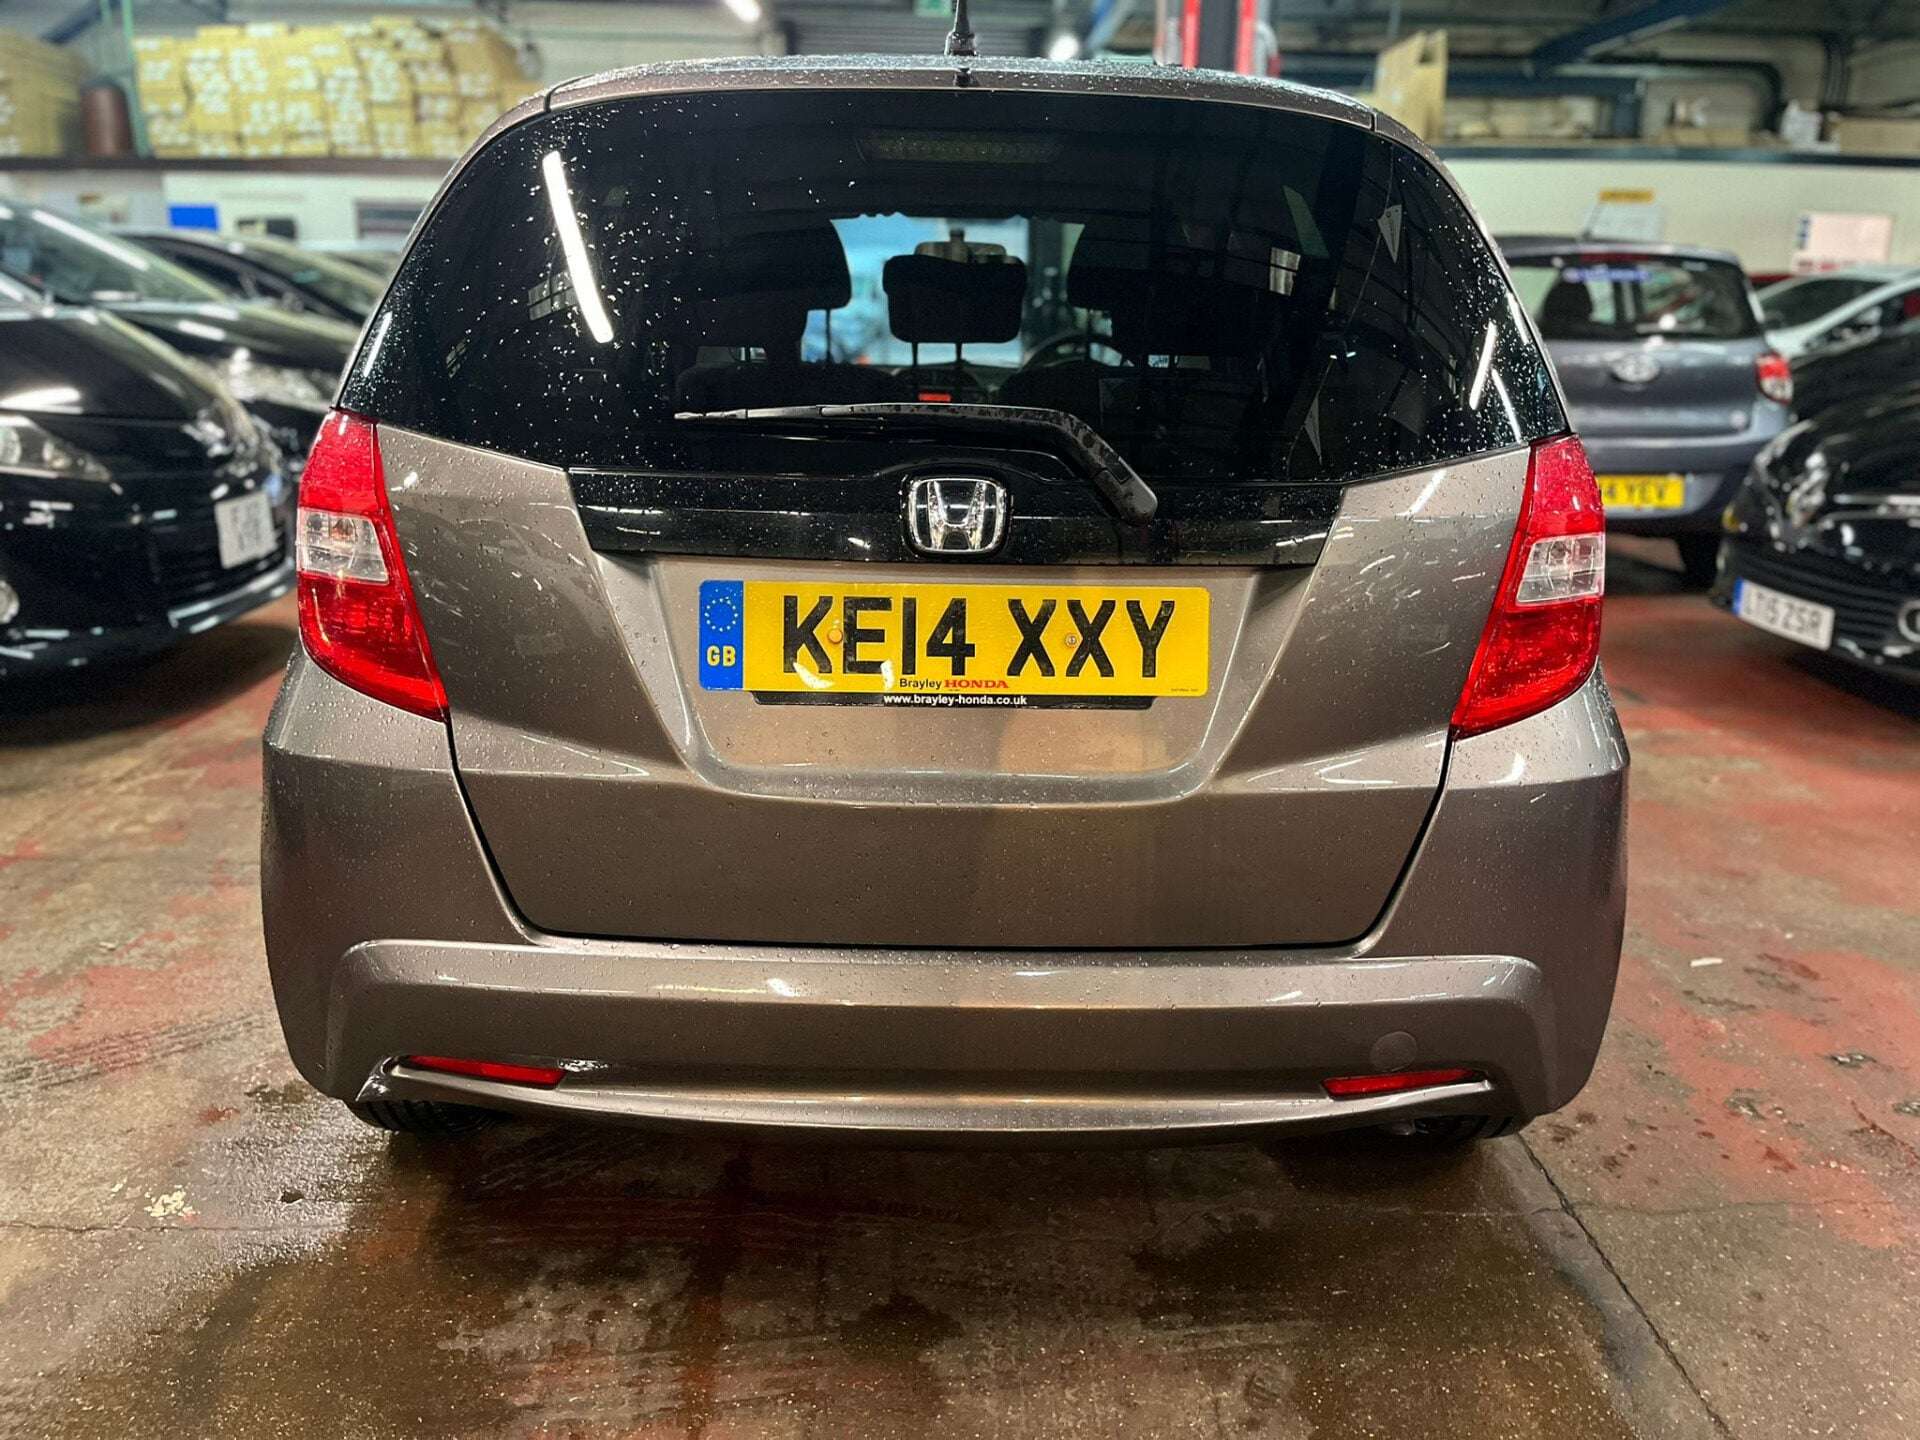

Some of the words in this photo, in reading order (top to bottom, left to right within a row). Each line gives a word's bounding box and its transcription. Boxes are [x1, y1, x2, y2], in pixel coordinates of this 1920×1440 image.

[783, 595, 976, 676] KE14
[1006, 598, 1175, 678] XXY
[706, 645, 737, 667] GB
[899, 678, 942, 690] Brayley
[944, 679, 1009, 689] HONDA
[883, 694, 1028, 707] www.brayley-honda.co.uk
